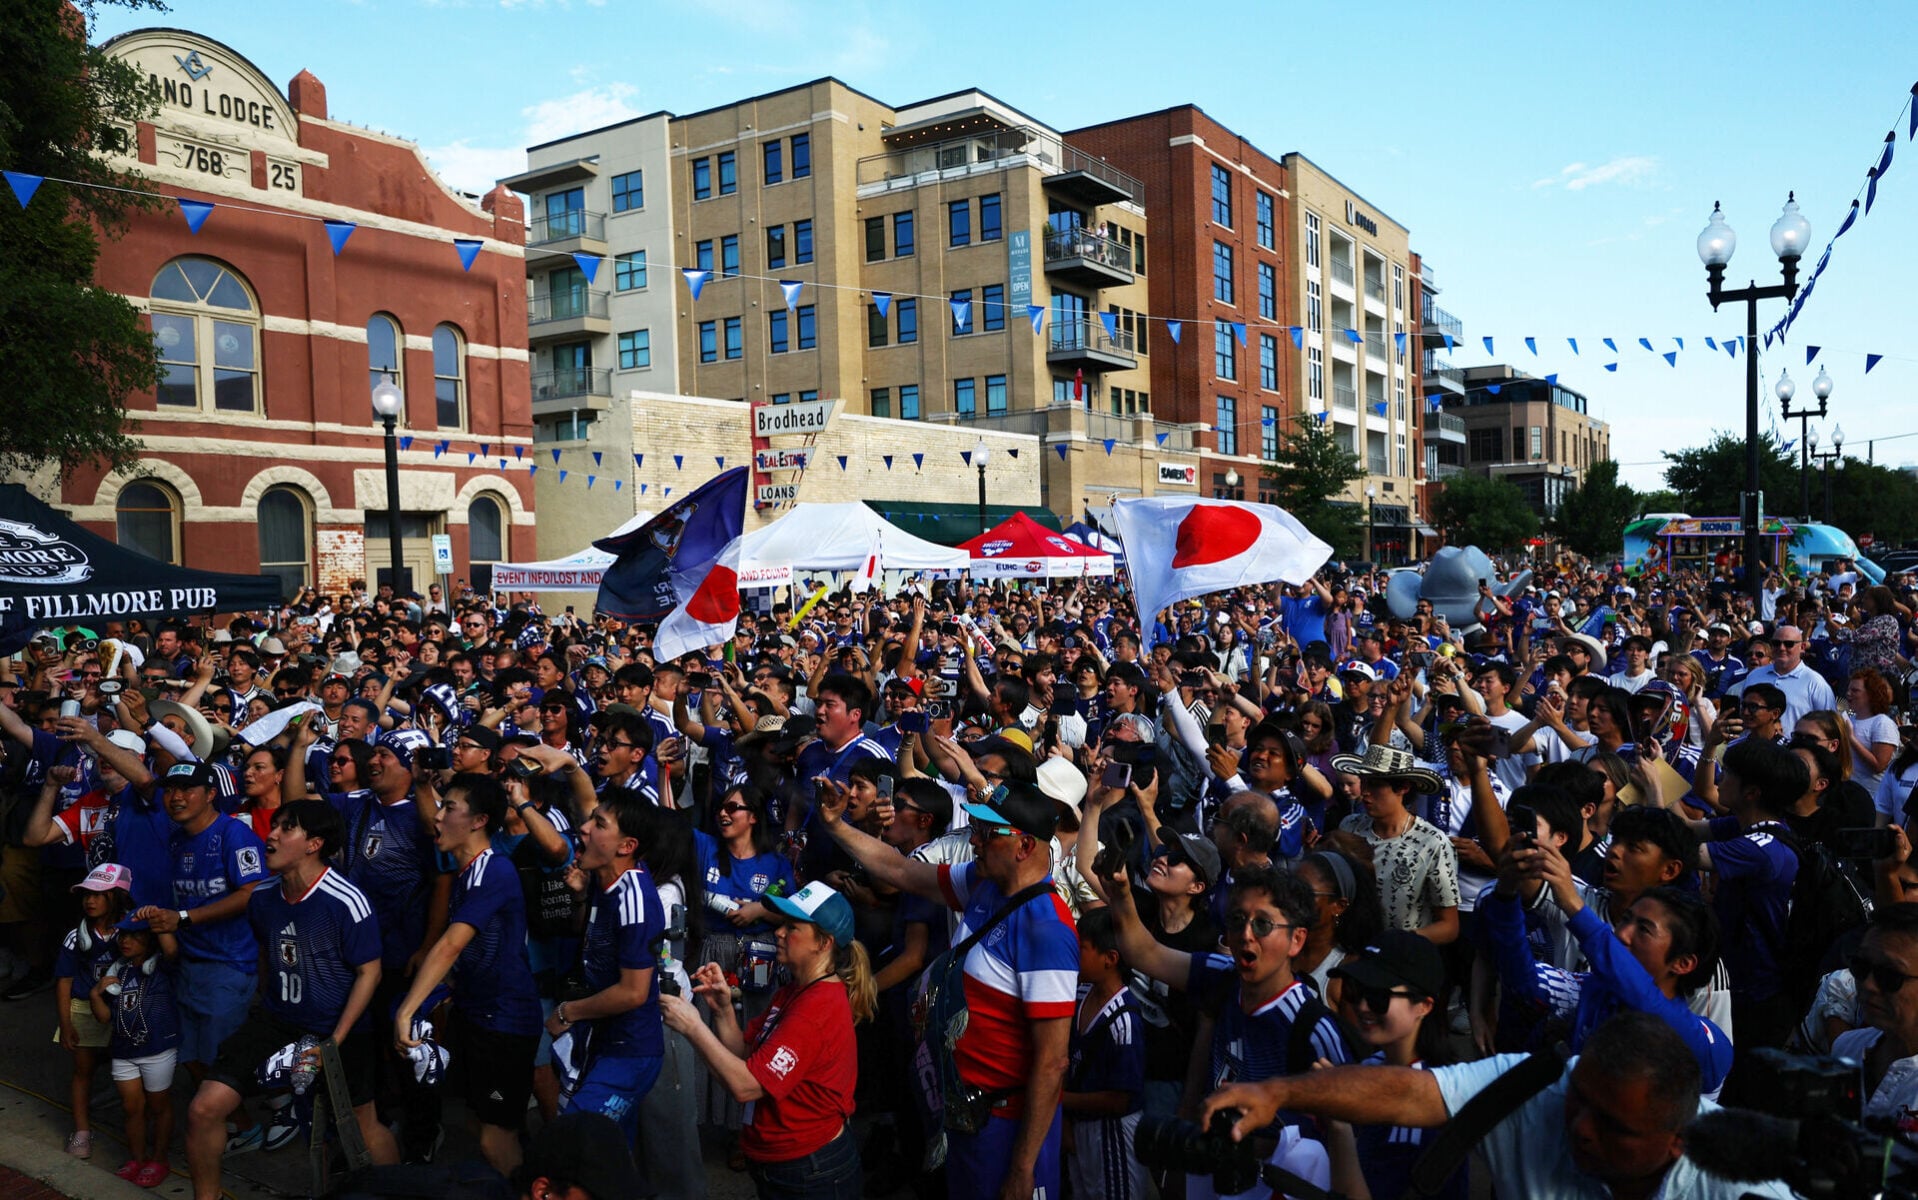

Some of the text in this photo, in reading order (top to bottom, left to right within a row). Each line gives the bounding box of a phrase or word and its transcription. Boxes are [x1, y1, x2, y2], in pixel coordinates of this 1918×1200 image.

[204, 89, 274, 129] LODGE
[183, 145, 223, 175] 768
[271, 164, 295, 191] 25
[759, 406, 824, 430] Brodhead
[761, 486, 795, 499] LOANS
[497, 571, 600, 585] EVENT INFO/LOST AND
[740, 567, 790, 582] AND FOUND
[23, 590, 164, 619] FILLMORE
[169, 588, 217, 610] PUB
[547, 881, 565, 892] like
[541, 894, 572, 906] boring
[542, 907, 572, 919] things
[279, 971, 301, 1004] 10
[603, 1094, 630, 1116] JUST
